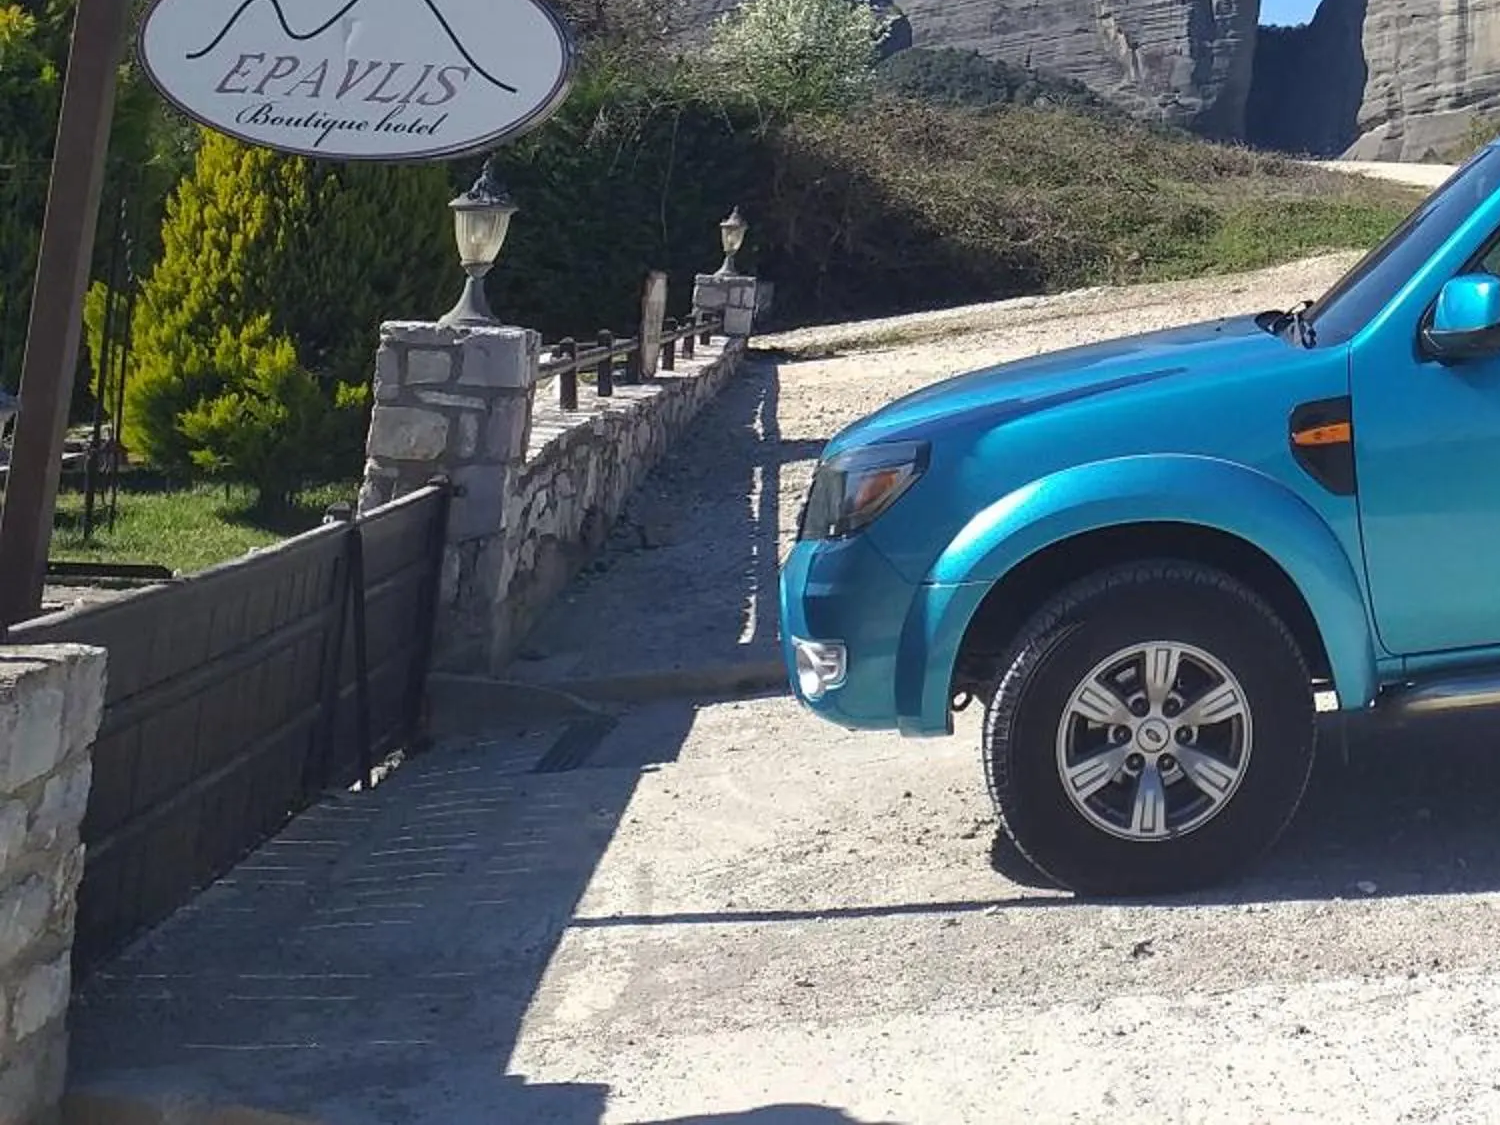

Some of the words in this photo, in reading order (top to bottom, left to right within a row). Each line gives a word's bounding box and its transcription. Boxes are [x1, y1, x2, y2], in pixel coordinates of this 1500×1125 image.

[216, 53, 470, 105] EPAVLIS
[235, 102, 369, 147] Boutique
[373, 104, 448, 135] hotel
